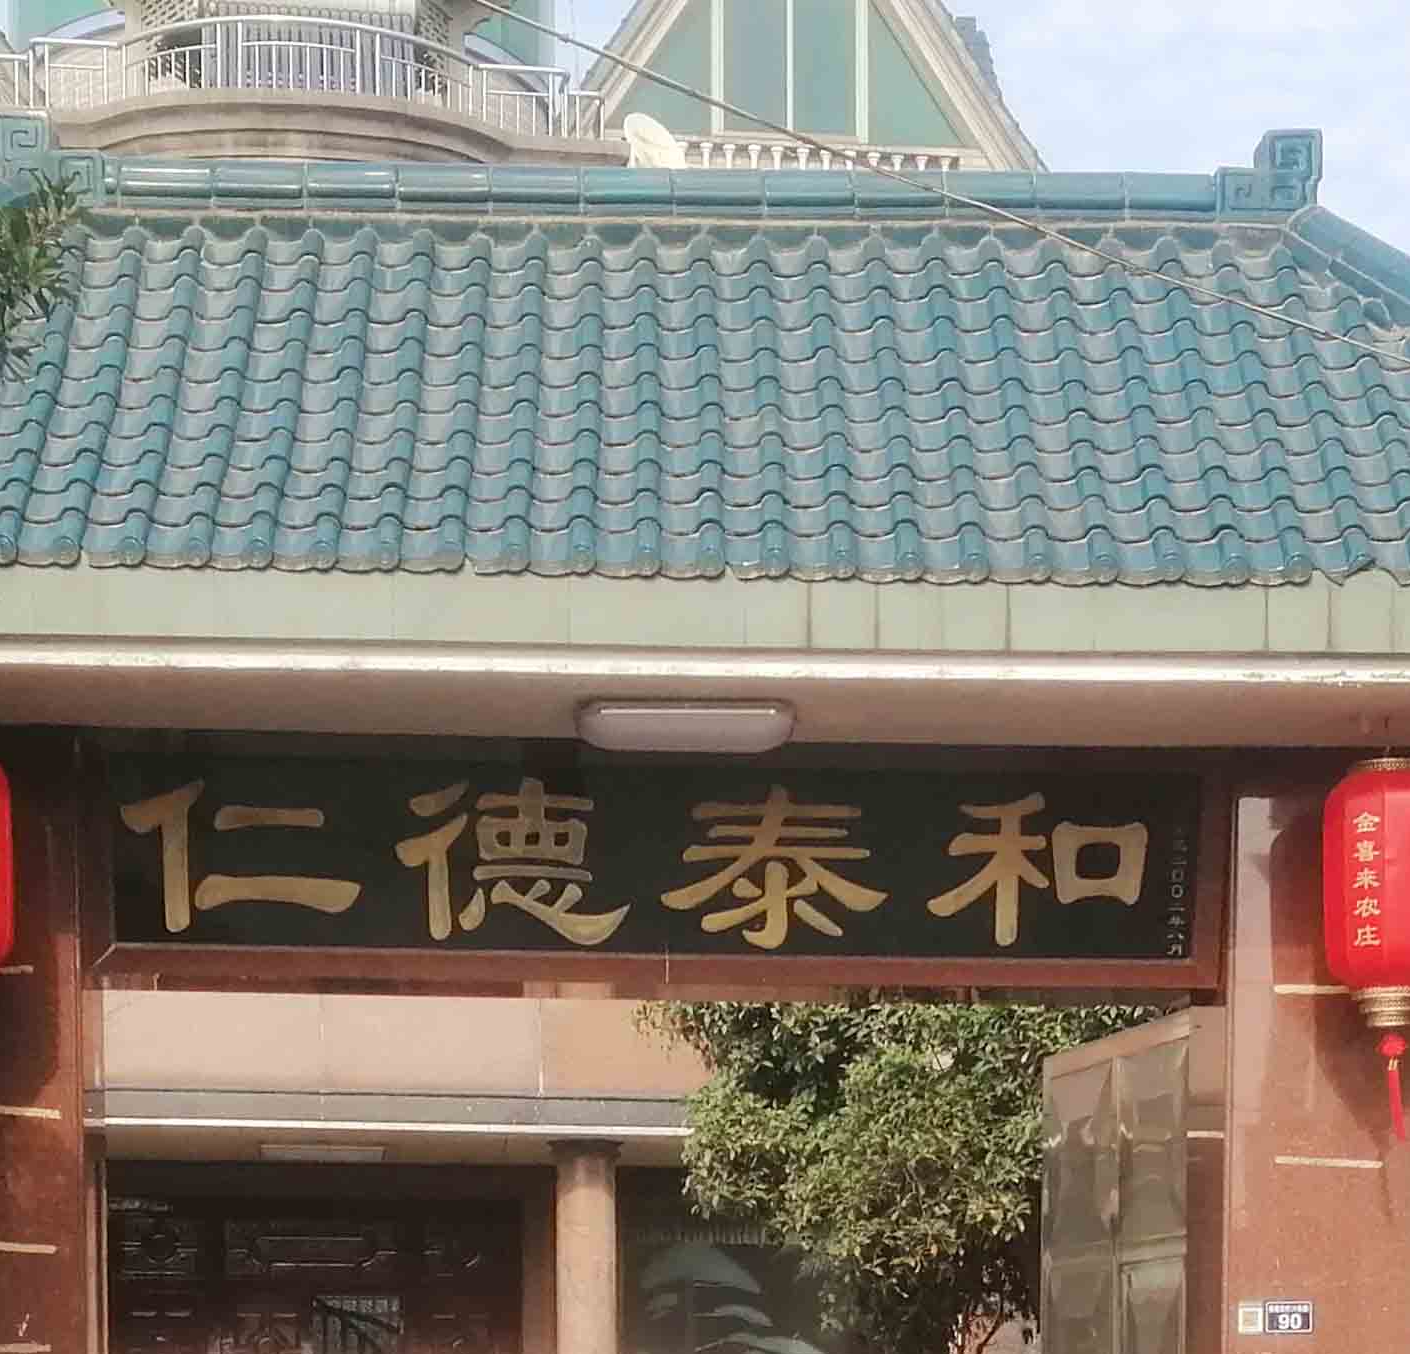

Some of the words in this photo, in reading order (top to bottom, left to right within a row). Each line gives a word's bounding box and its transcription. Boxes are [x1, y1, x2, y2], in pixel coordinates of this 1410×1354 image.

[119, 777, 1149, 948] 仁德泰和
[1352, 811, 1382, 946] 金喜来农庄
[1278, 1313, 1302, 1329] 90
